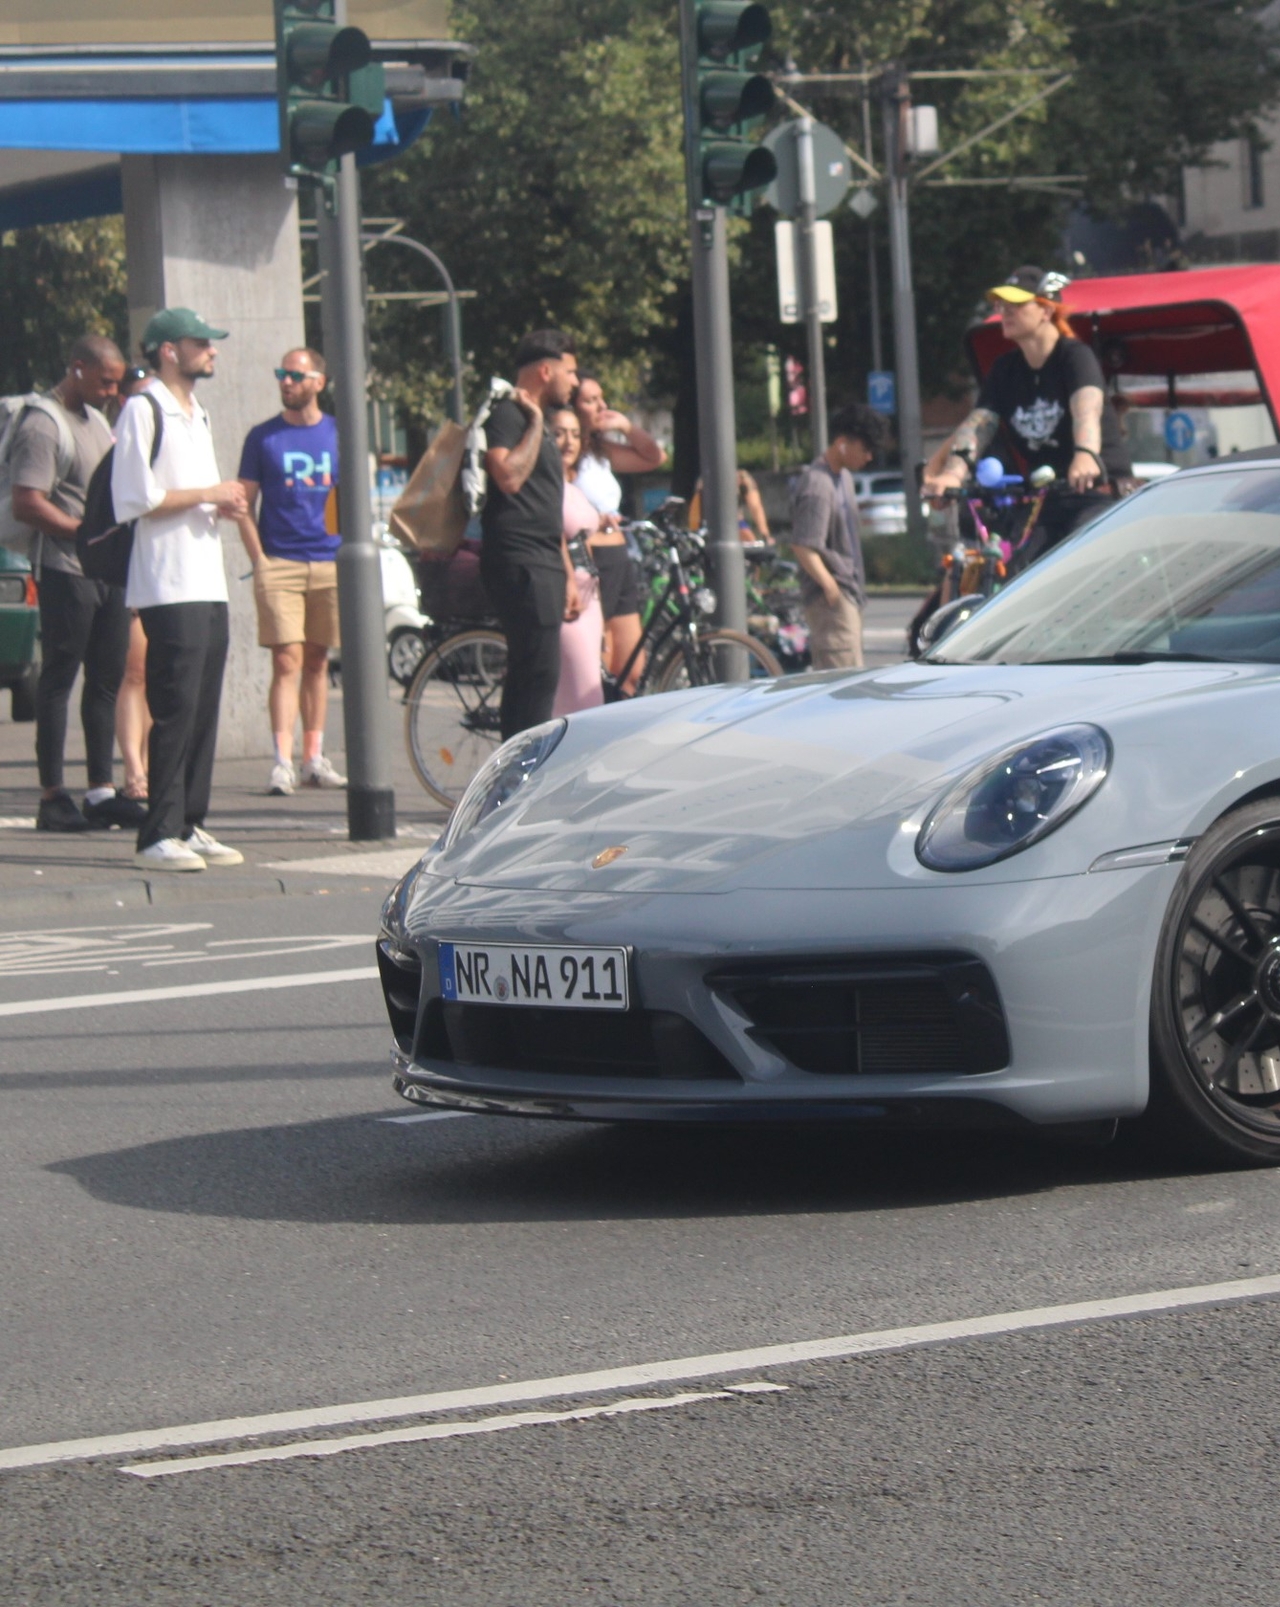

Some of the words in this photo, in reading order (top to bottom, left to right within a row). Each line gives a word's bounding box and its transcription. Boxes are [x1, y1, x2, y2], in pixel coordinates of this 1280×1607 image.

[455, 950, 492, 996] NR
[511, 953, 552, 999] NA
[560, 955, 622, 1001] 911
